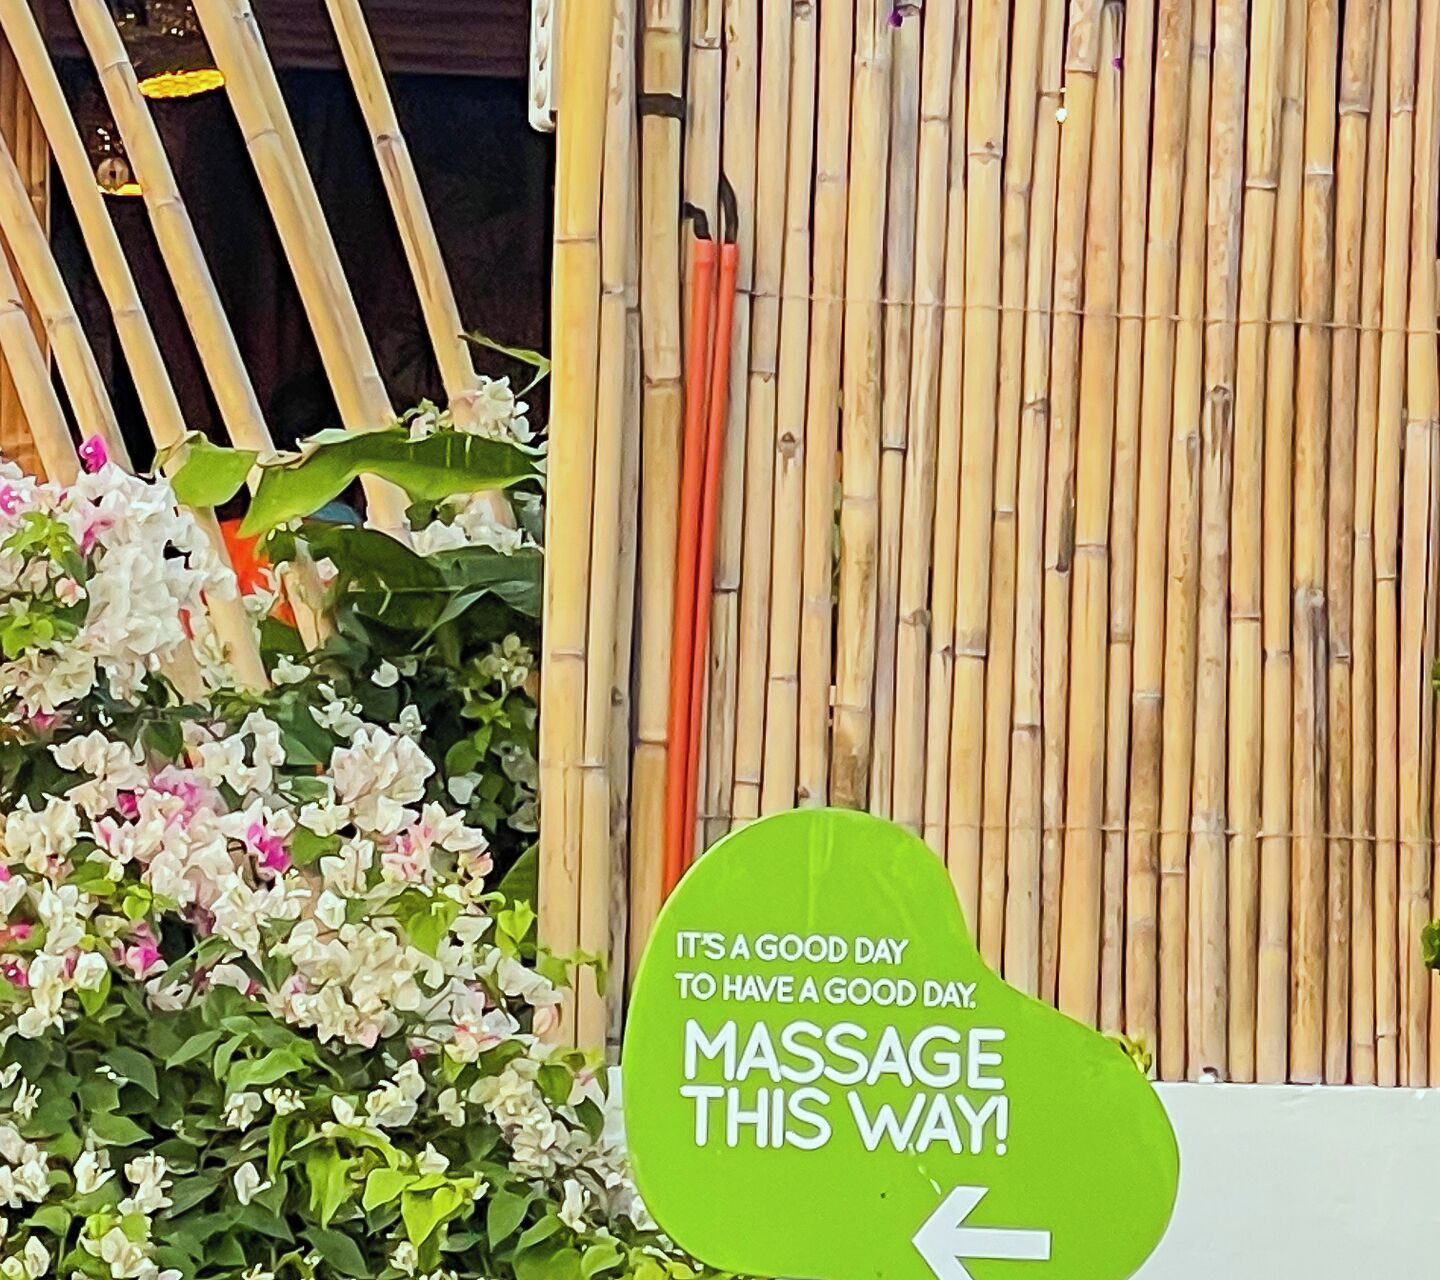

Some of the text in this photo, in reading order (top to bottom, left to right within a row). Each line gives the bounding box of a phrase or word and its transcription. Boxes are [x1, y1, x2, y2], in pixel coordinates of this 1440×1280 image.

[676, 931, 908, 965] IT'S A GOOD DAY
[675, 972, 717, 1001] TO
[723, 974, 794, 1004] HAVE
[798, 977, 820, 1004] A
[824, 977, 917, 1008] GOOD
[684, 1018, 1007, 1091] MASSAGE
[679, 1084, 1010, 1156] THIS WAY!
